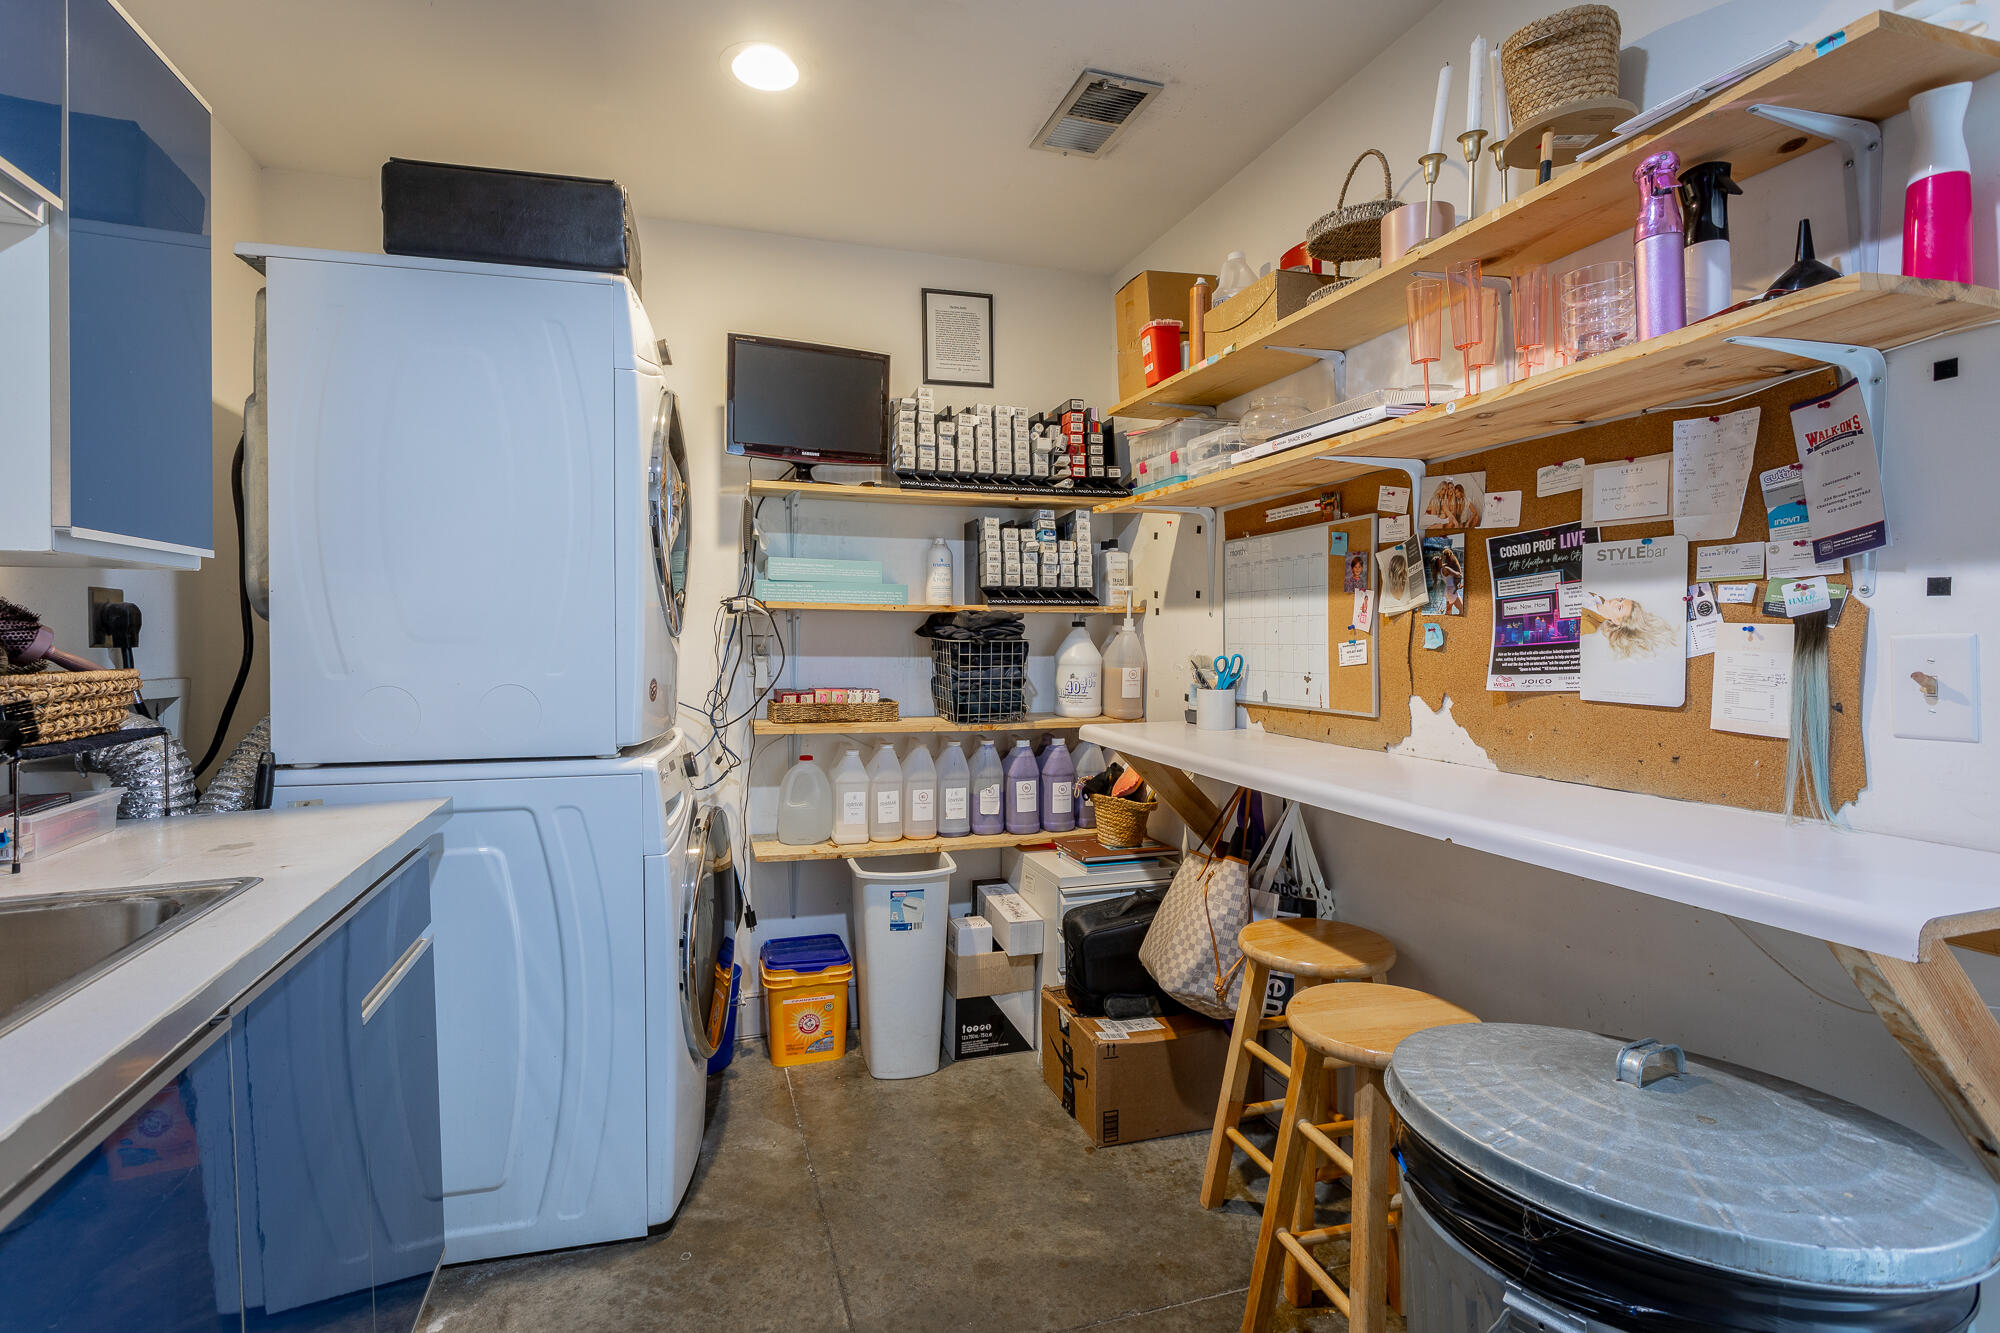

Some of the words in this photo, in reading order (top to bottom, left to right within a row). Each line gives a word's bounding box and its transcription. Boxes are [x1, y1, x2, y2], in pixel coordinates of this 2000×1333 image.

[1500, 541, 1531, 558] COSMO
[1533, 538, 1556, 553] PROF
[1560, 530, 1586, 549] LIVE
[1597, 545, 1668, 561] STYLEbar
